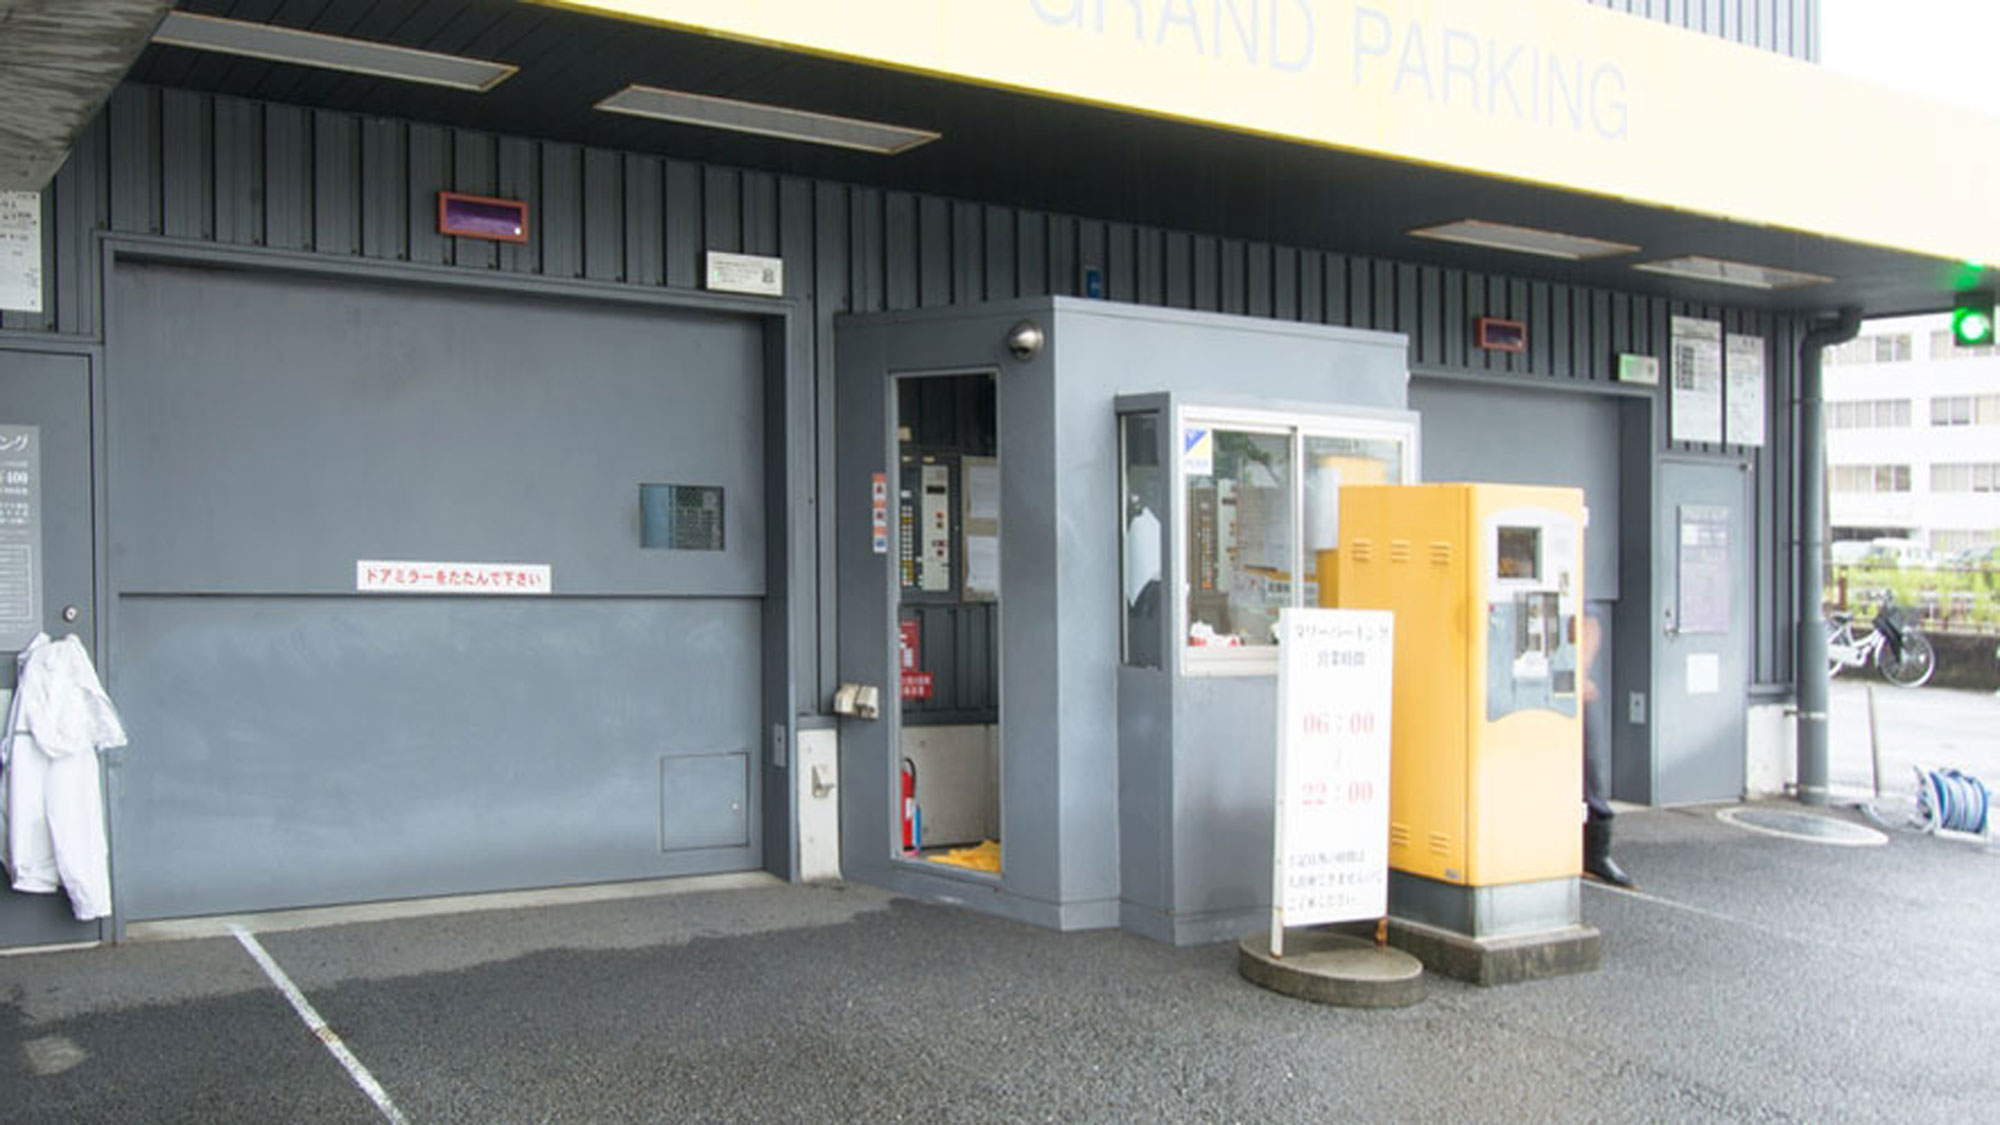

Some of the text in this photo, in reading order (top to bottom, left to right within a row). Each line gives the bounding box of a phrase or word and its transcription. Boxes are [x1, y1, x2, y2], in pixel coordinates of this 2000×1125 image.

[1029, 0, 1630, 143] AND PARKING
[366, 567, 542, 587] ドアミラーをたたんで下さい
[1316, 649, 1366, 668] 営業時間
